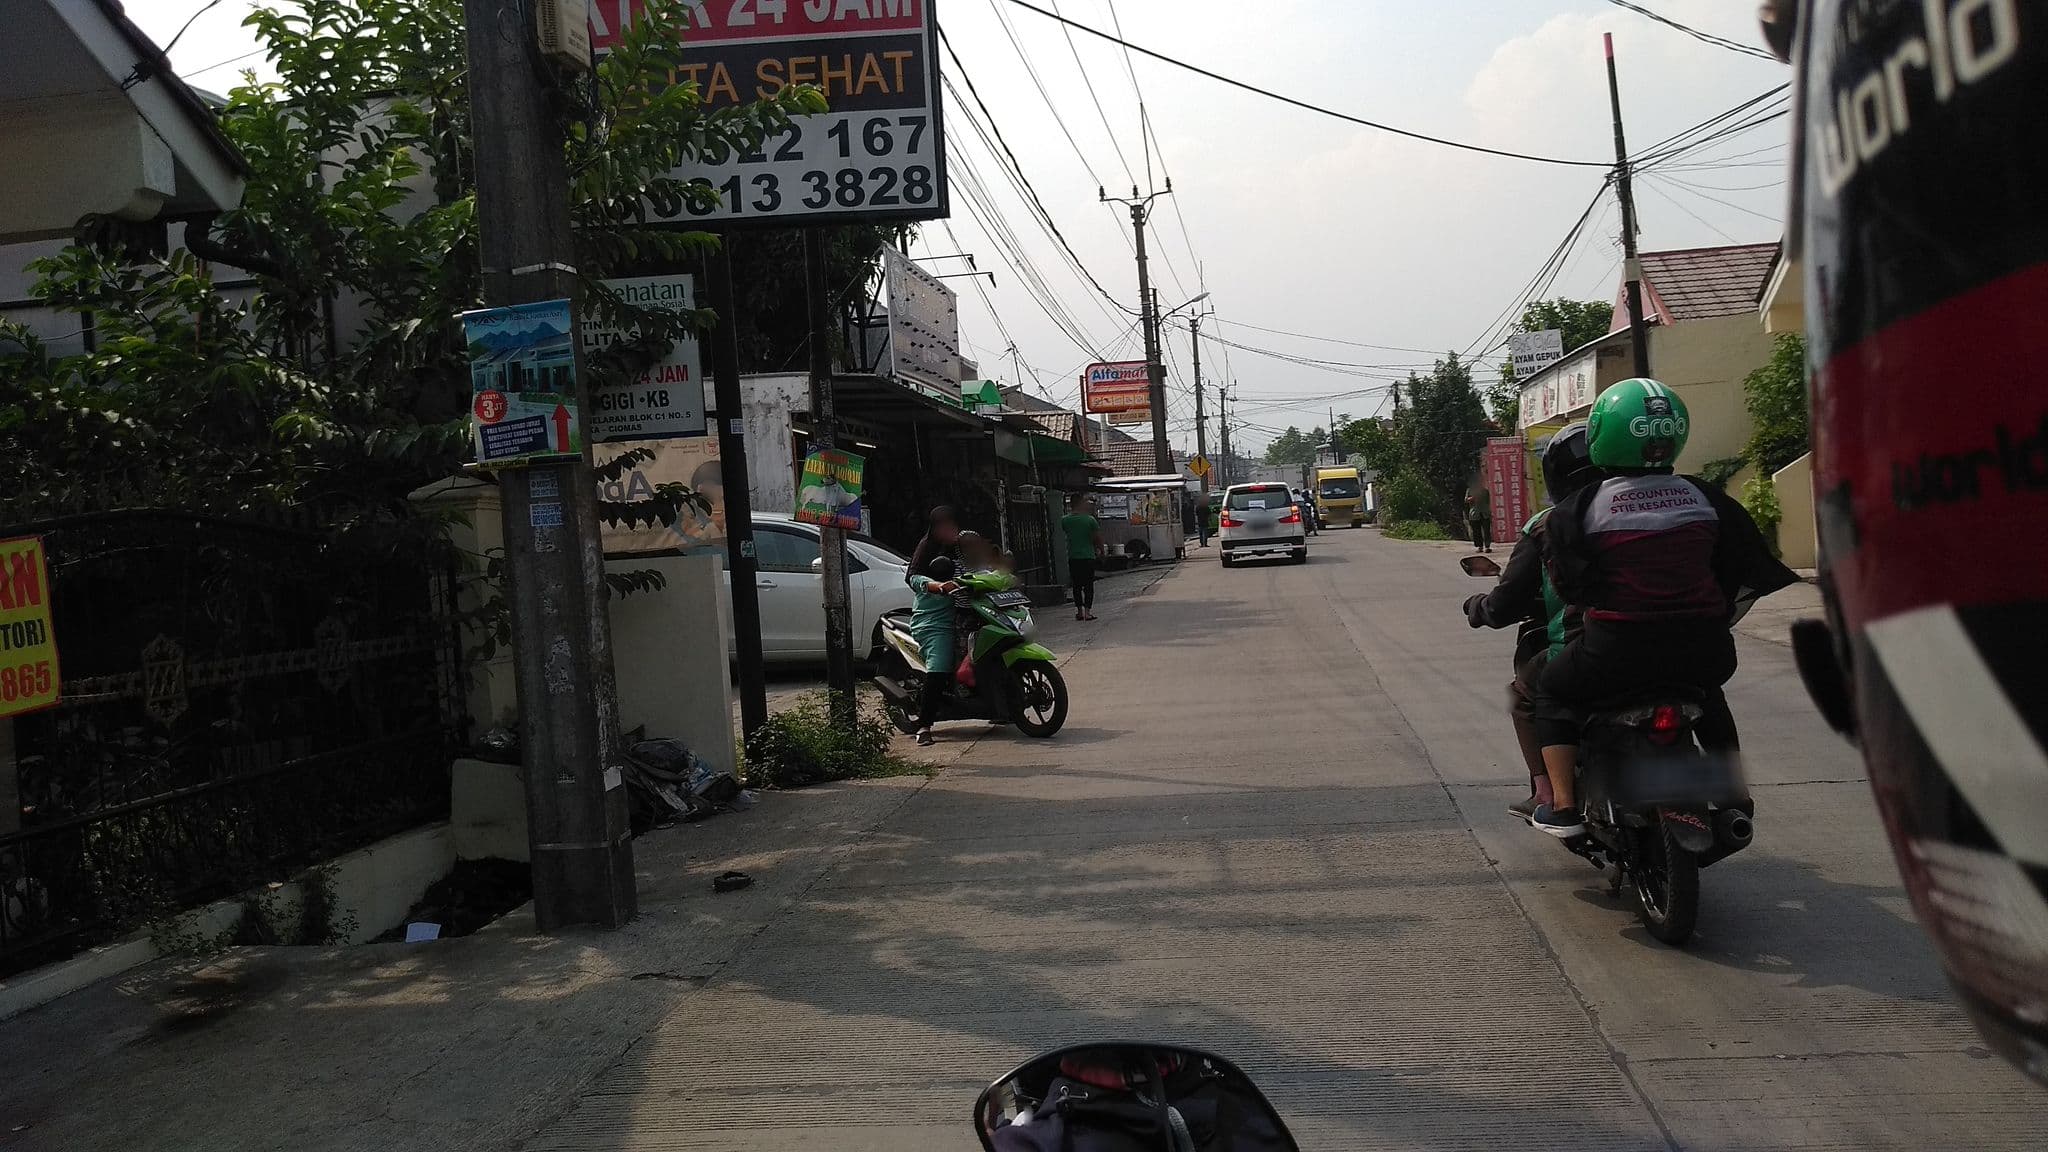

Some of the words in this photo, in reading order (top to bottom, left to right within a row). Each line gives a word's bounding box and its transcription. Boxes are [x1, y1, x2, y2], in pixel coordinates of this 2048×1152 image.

[756, 50, 914, 101] SEHAT
[827, 115, 928, 159] 167
[800, 164, 934, 210] 3828
[1514, 354, 1536, 364] AYAM
[1536, 351, 1561, 362] GEPUK
[655, 364, 690, 384] JAM
[1091, 367, 1148, 382] Alfamar
[600, 391, 635, 411] GIGI
[629, 413, 652, 423] BLOK
[1629, 410, 1687, 438] Grab
[608, 423, 642, 433] CIOMAS
[1611, 487, 1691, 504] ACCOUNTING
[1610, 504, 1636, 514] STIE
[1638, 498, 1699, 512] KESATUAN
